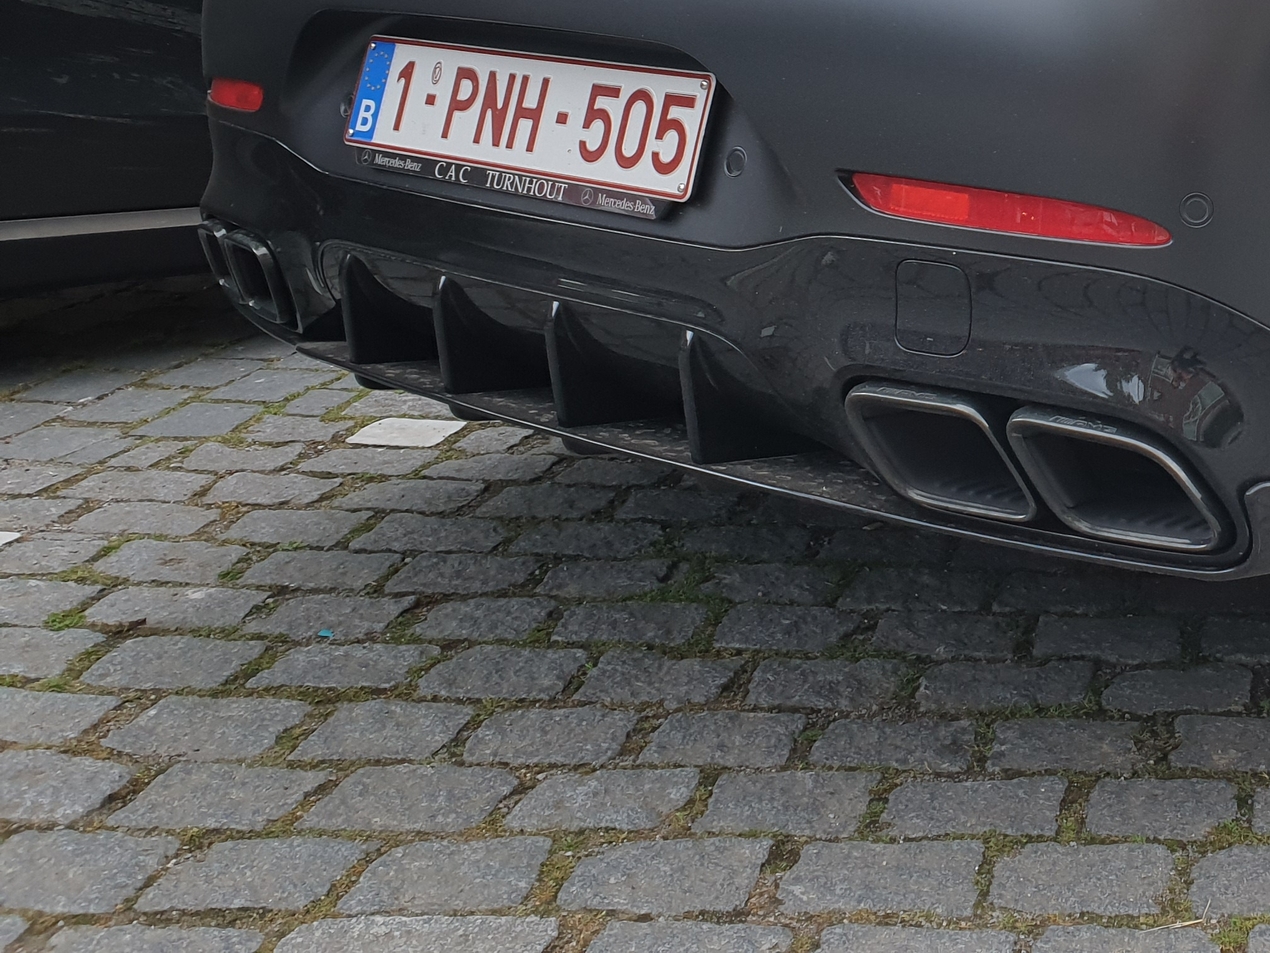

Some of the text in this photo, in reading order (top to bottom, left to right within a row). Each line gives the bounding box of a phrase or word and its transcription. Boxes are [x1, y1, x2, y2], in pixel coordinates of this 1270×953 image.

[355, 98, 376, 132] B
[392, 60, 698, 176] 1-PNH-505
[374, 153, 422, 172] Mercedes-Benz
[486, 170, 568, 201] TURNHOUT
[595, 193, 655, 215] Mercedes-Benz
